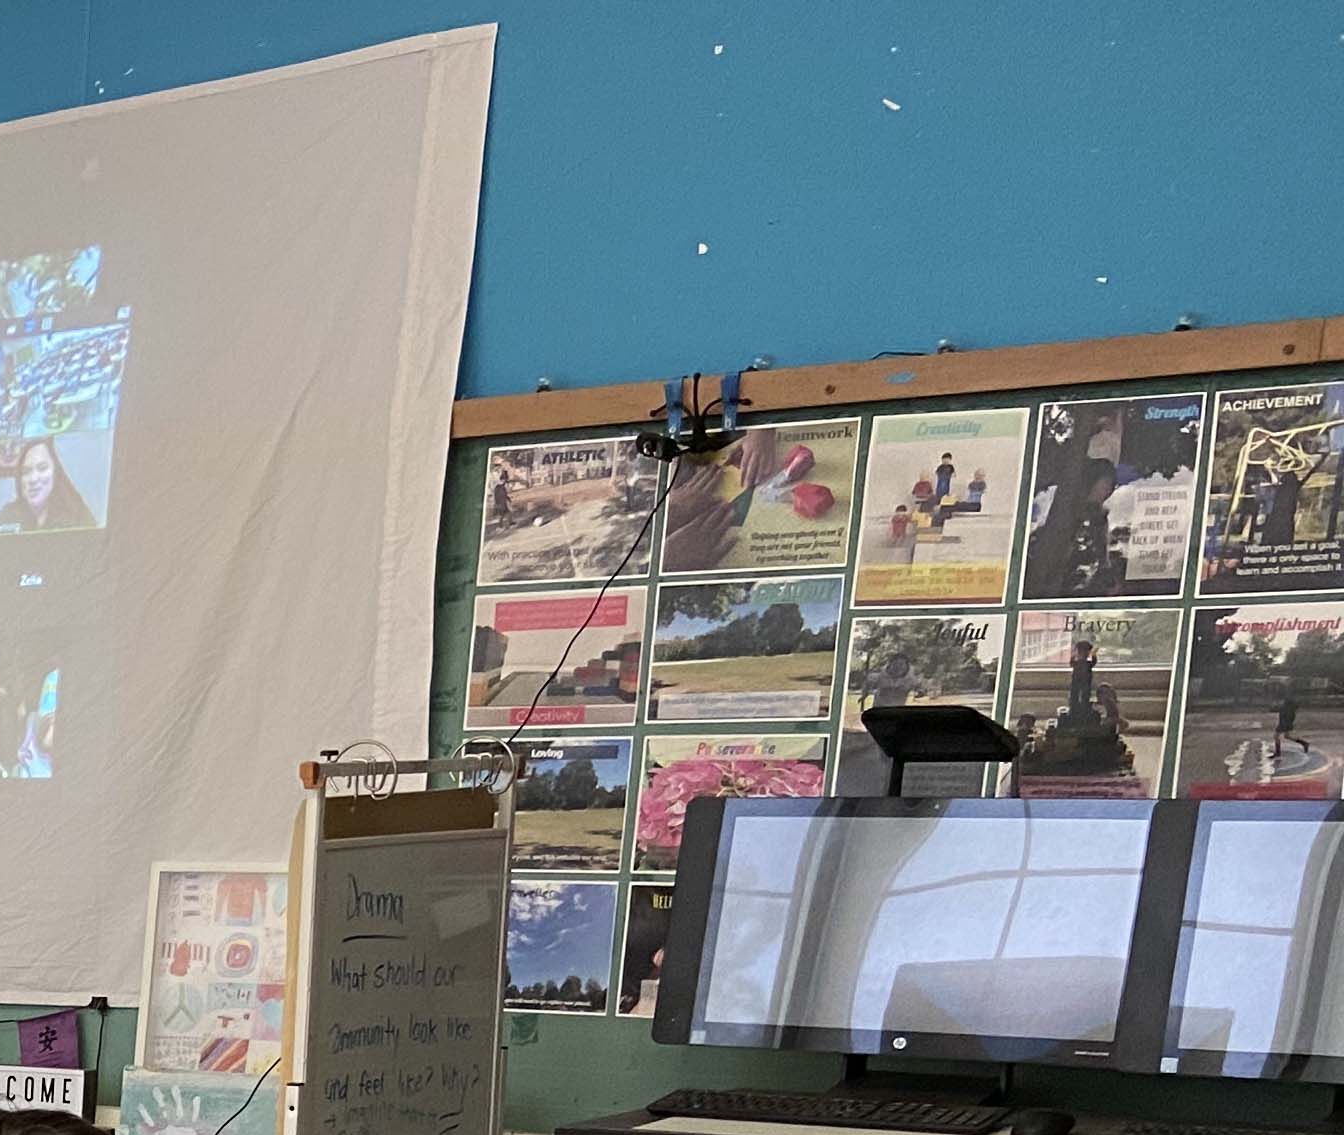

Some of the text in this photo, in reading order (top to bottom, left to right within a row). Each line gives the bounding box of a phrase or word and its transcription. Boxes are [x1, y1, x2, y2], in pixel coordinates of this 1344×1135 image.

[1222, 393, 1324, 413] ACHIEVEMENT
[1145, 405, 1200, 421] Strength
[777, 427, 857, 441] Teamwork
[916, 421, 982, 438] Creativity
[542, 449, 606, 465] ATHLETIC
[1244, 543, 1272, 553] When
[1273, 543, 1290, 555] you
[1243, 551, 1341, 565] there is only space to
[1236, 563, 1334, 576] learn and accomplish
[1063, 615, 1136, 634] Bravery
[932, 623, 989, 646] Joyful
[515, 707, 579, 723] Ceativity
[531, 748, 564, 760] Loving
[696, 742, 776, 757] Perseverance
[346, 873, 404, 924] Drama
[330, 951, 463, 992] What should our
[408, 1014, 439, 1043] look
[446, 1015, 472, 1041] like
[38, 1026, 58, 1053] 安
[325, 1064, 480, 1104] and feel like? Why?
